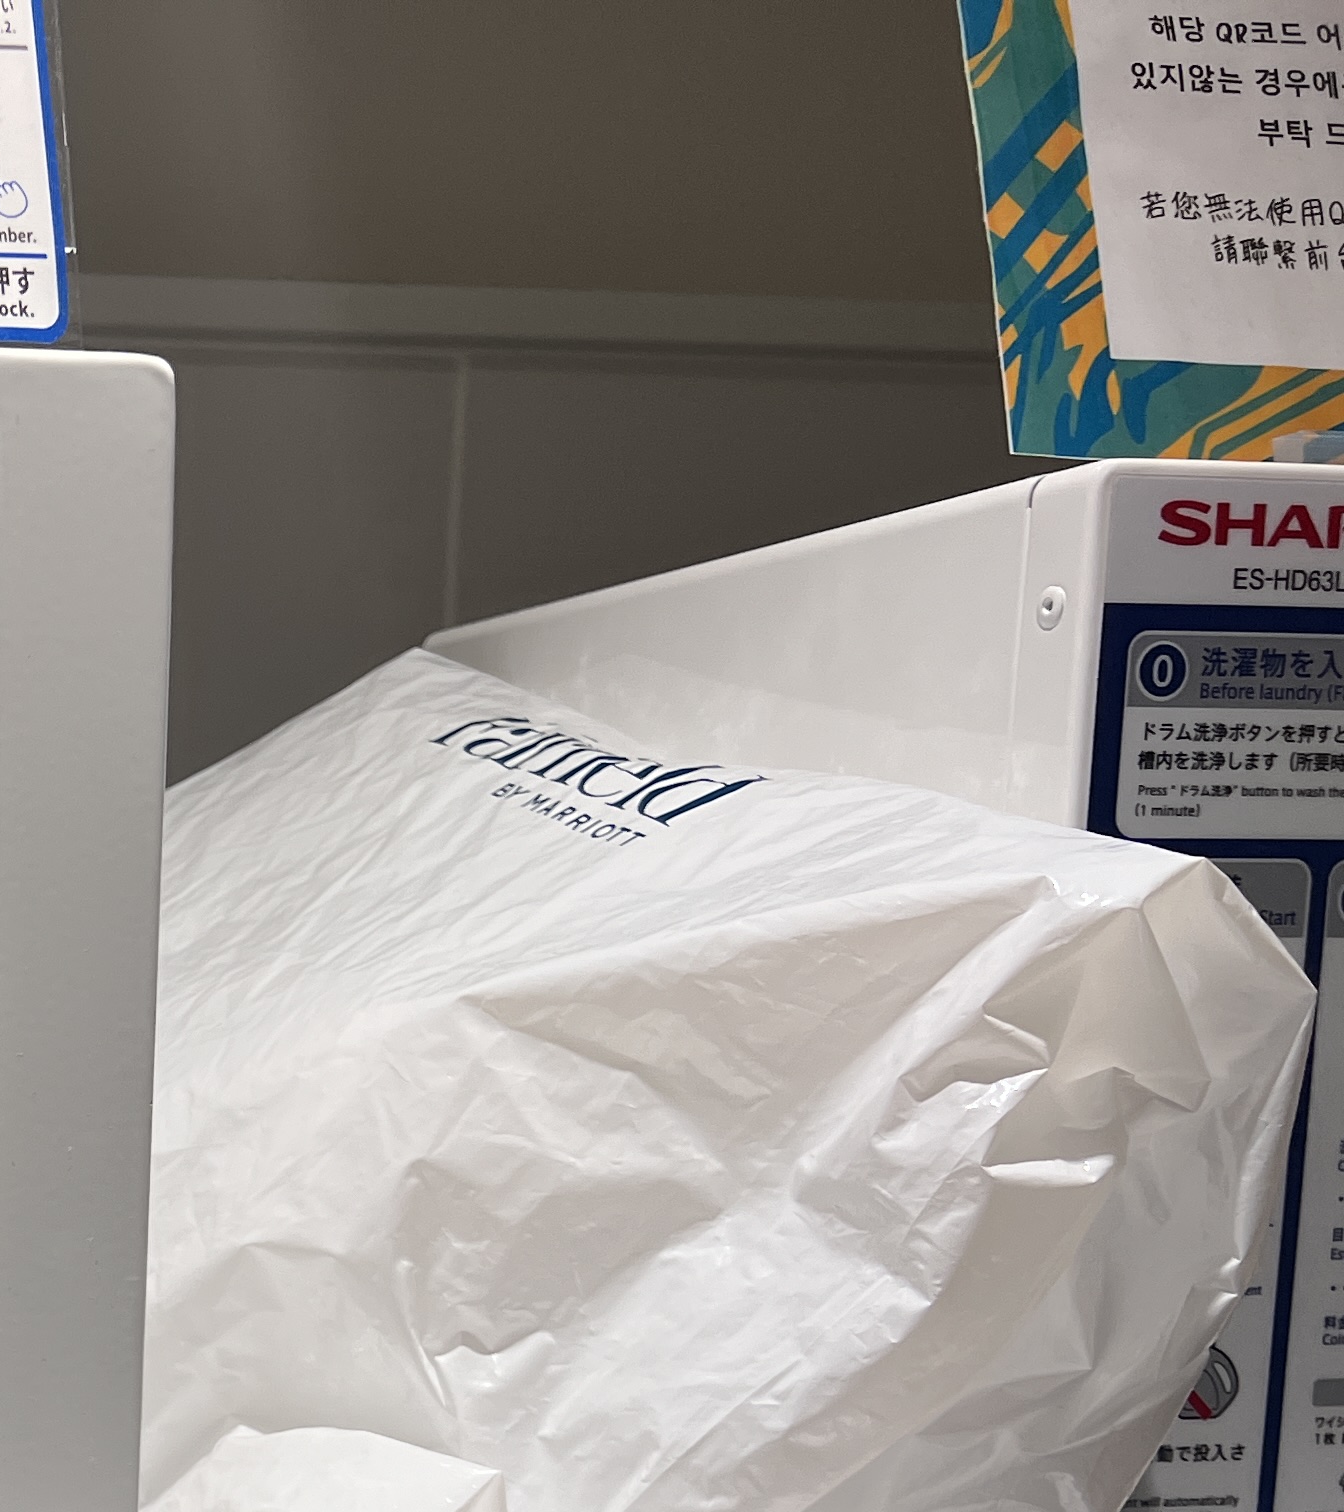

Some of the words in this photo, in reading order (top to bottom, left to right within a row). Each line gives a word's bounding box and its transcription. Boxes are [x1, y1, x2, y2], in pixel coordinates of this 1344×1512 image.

[1149, 15, 1204, 42] 해당
[1216, 22, 1306, 44] QR코드
[1258, 119, 1312, 148] 부탁
[1213, 235, 1344, 270] 請聯繫前
[1200, 683, 1254, 699] Before
[1260, 684, 1323, 704] laundry
[522, 793, 647, 846] MARRIOTT
